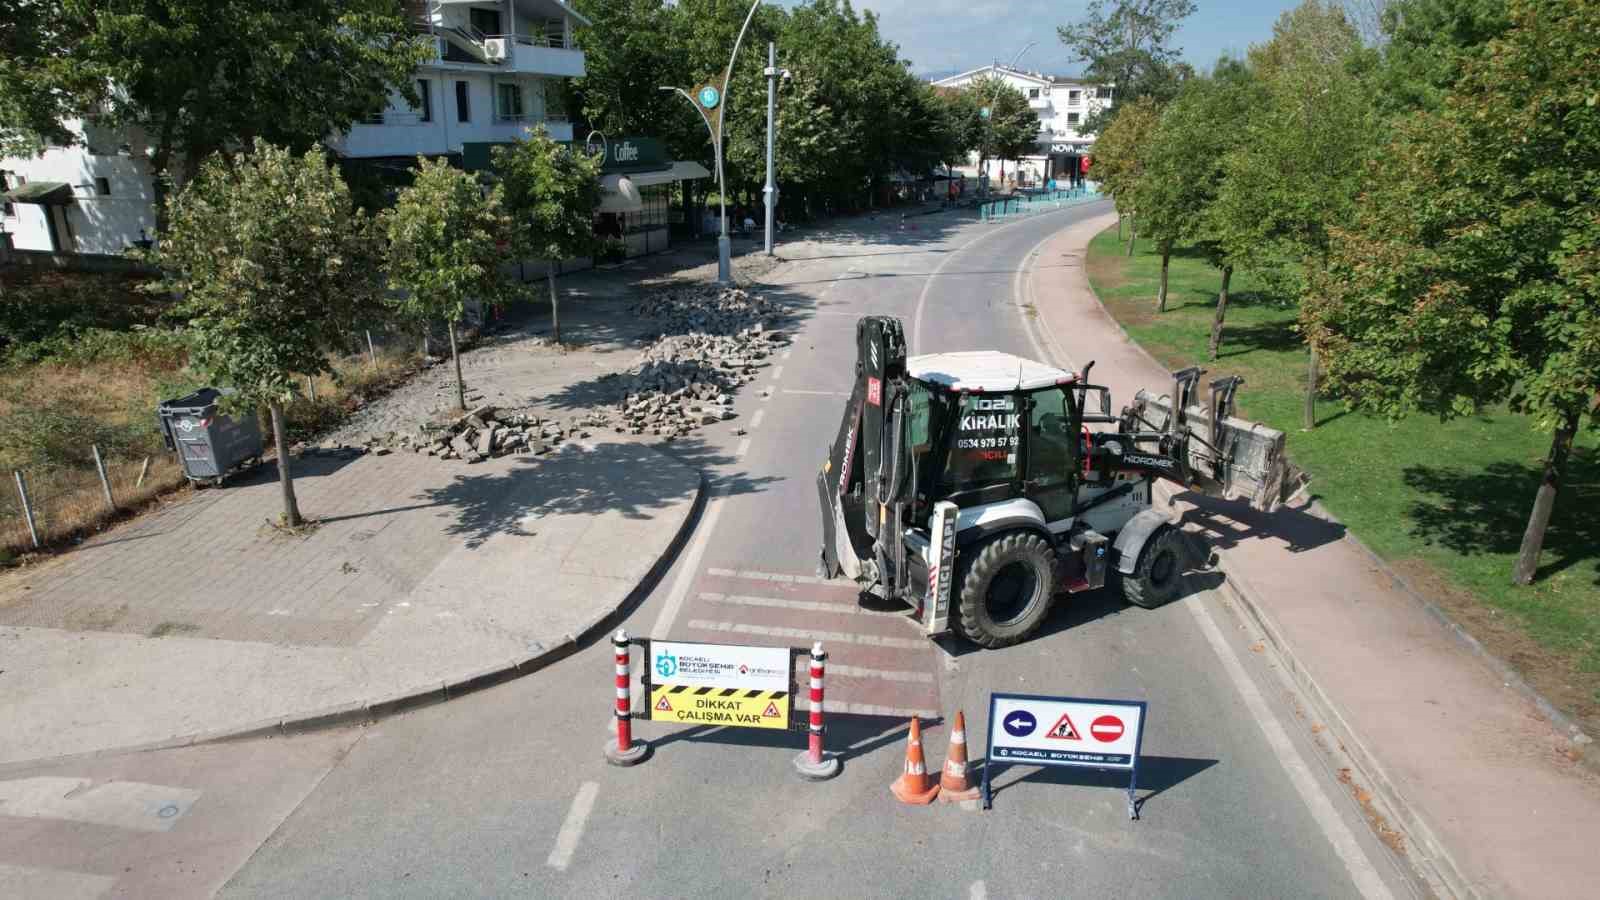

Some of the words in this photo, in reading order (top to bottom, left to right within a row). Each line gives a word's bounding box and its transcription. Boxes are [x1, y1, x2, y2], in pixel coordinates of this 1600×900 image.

[614, 142, 638, 161] Coffee
[1051, 143, 1075, 153] NOVA
[958, 438, 979, 449] 0534
[998, 436, 1008, 447] 57
[942, 518, 954, 561] YAPI
[696, 698, 742, 711] DİKKAT
[677, 710, 733, 723] ÇALIŞMA
[736, 713, 761, 724] VAR
